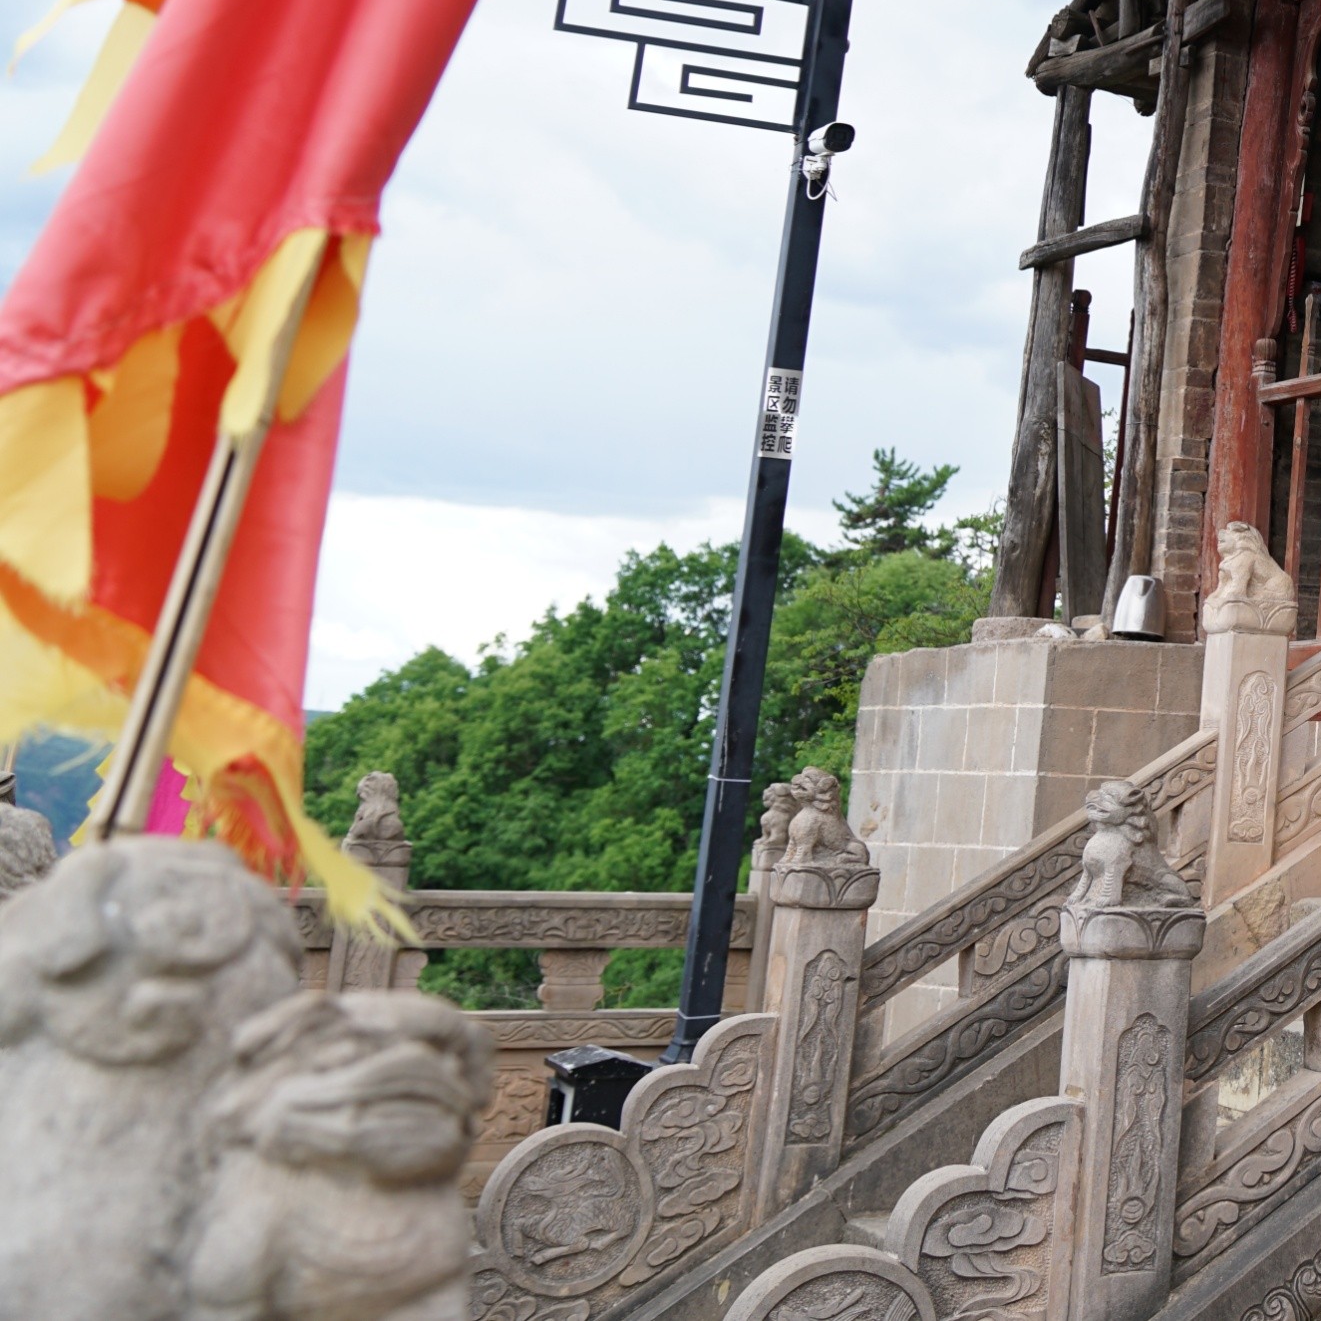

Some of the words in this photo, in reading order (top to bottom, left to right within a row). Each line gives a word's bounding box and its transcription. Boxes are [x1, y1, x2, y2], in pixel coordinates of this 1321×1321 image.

[760, 375, 783, 453] 景区监控
[777, 376, 800, 454] 请勿攀爬
